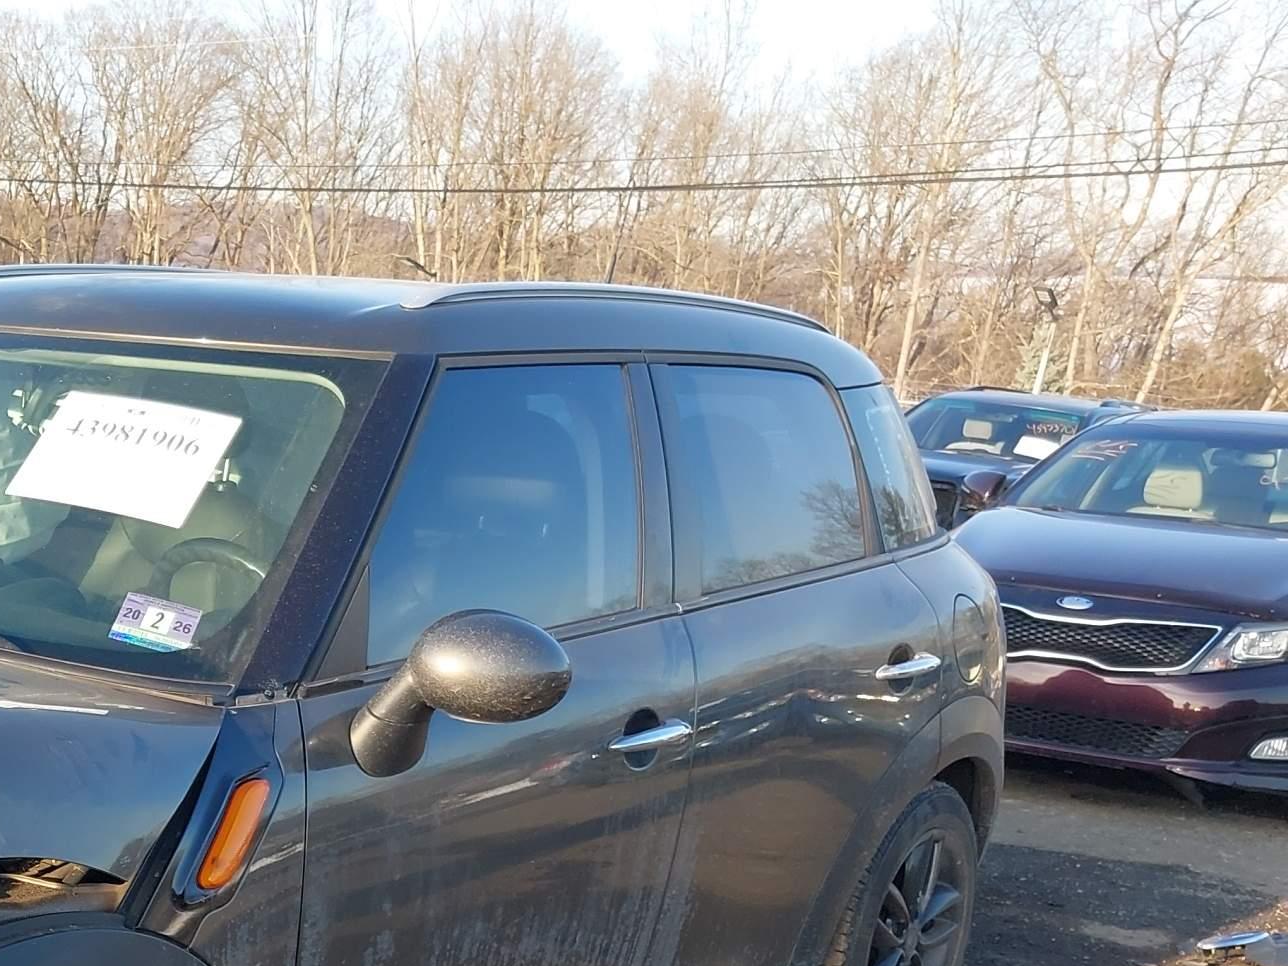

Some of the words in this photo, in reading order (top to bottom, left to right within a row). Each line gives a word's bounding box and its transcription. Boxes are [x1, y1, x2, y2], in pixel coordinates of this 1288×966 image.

[66, 418, 200, 456] 43981906
[122, 607, 142, 621] 20
[150, 611, 165, 630] 2
[173, 620, 193, 635] 26
